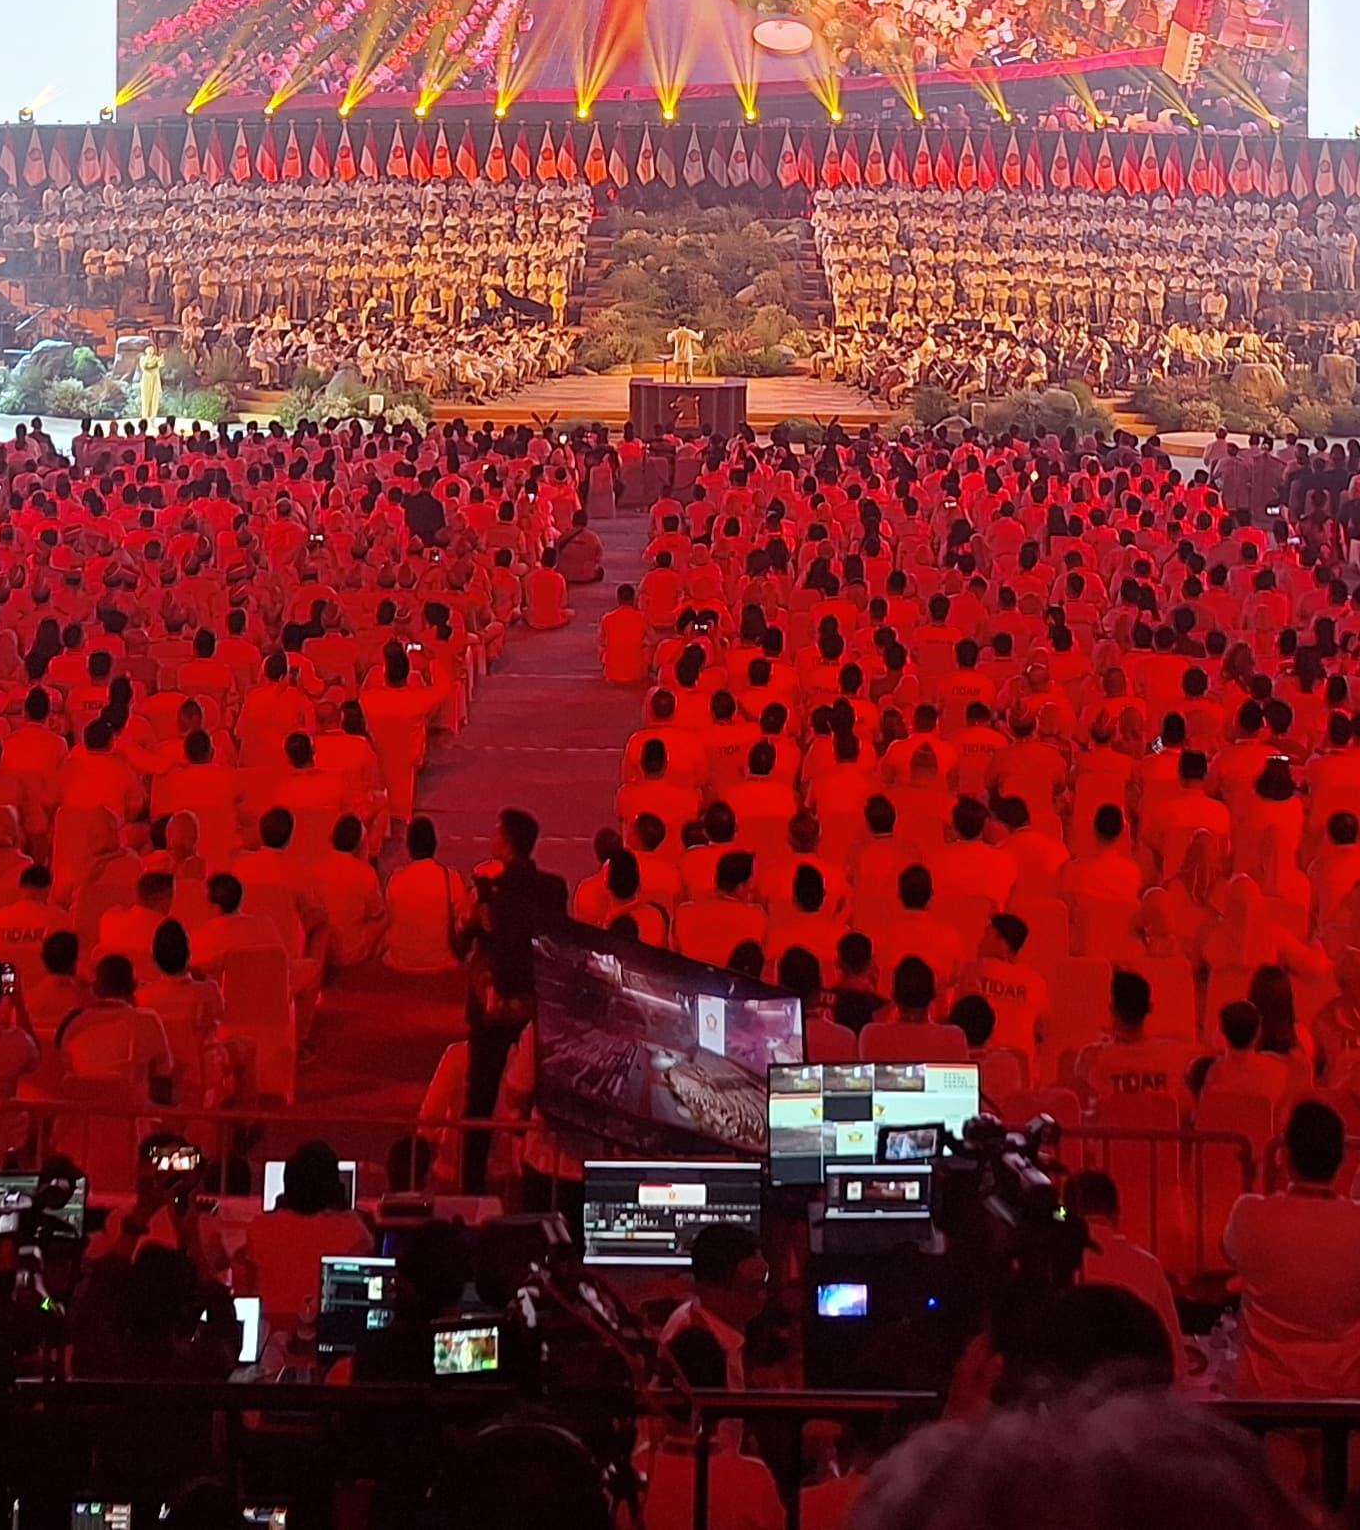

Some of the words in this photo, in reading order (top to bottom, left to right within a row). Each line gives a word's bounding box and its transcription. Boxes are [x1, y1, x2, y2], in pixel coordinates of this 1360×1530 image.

[1, 926, 47, 943] TIDAR
[979, 977, 1027, 1000] TIDAR
[1111, 1071, 1168, 1094] TIDAR
